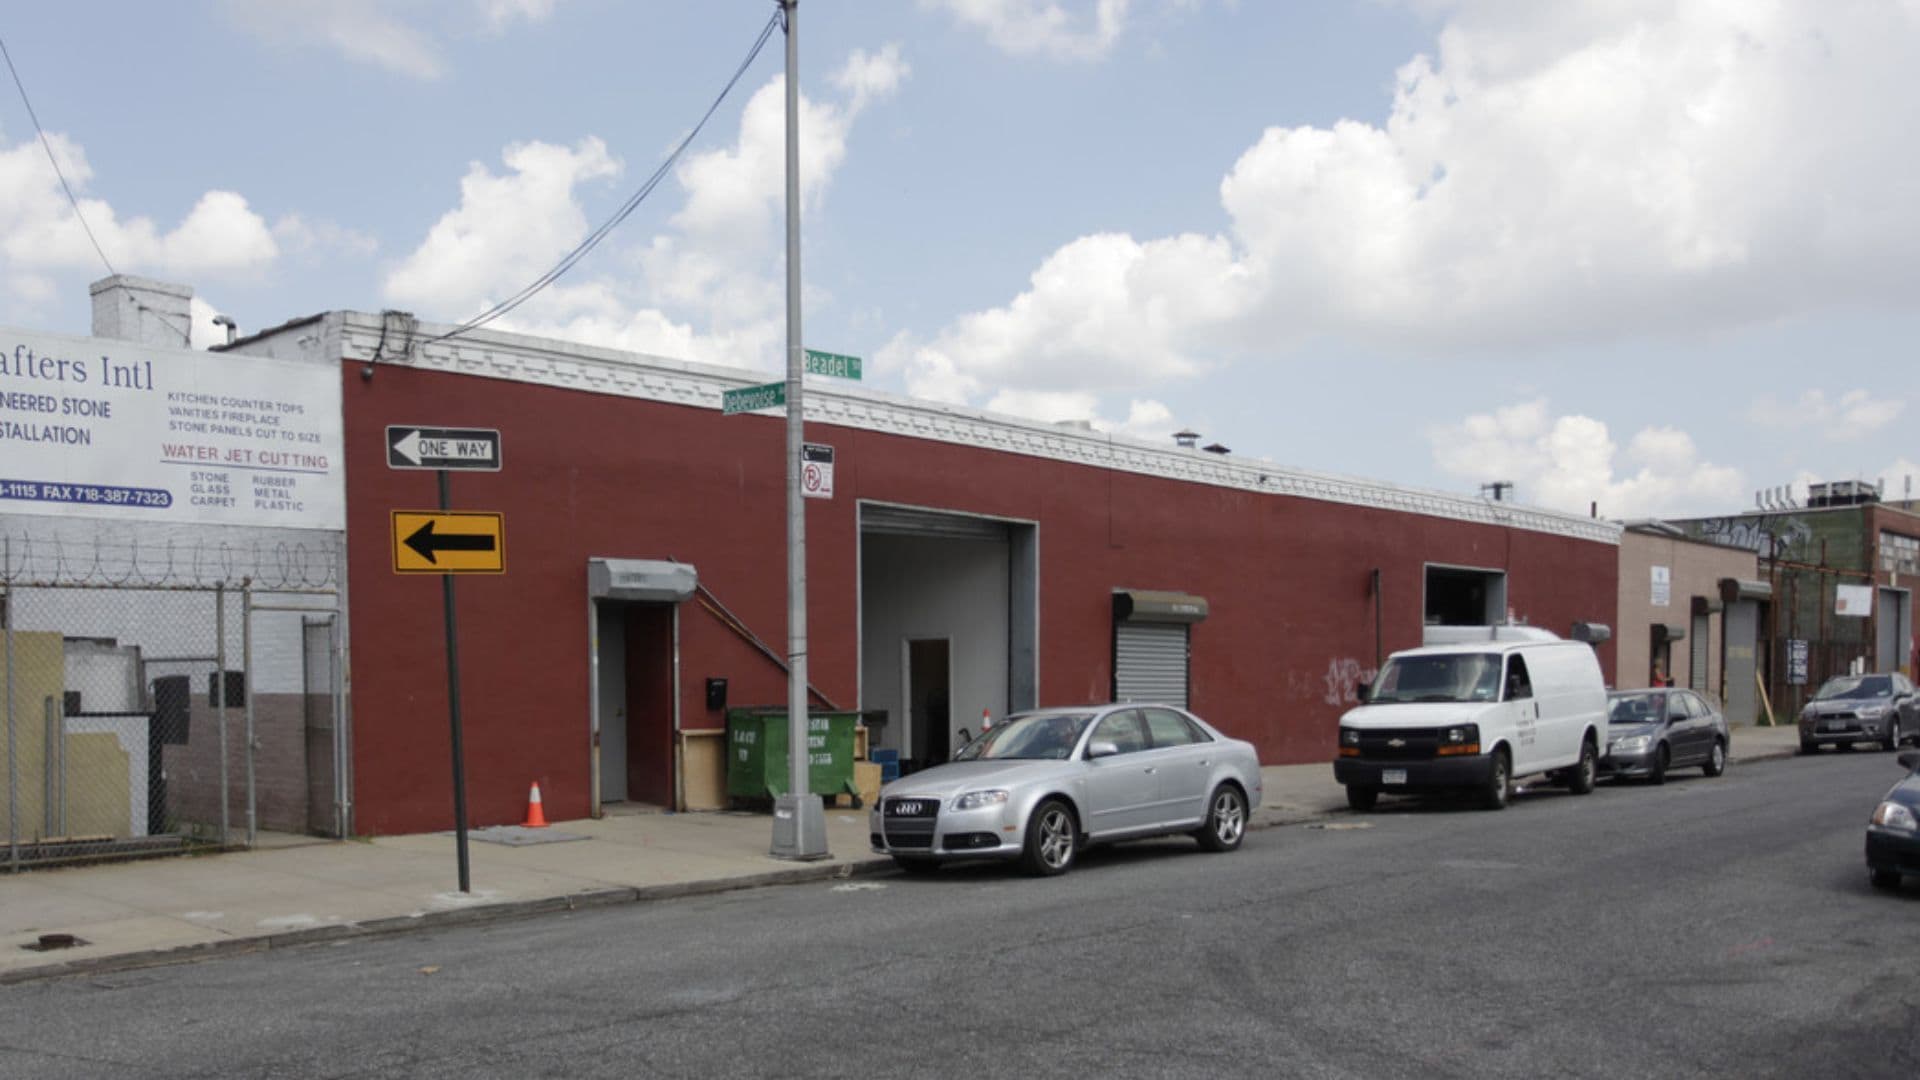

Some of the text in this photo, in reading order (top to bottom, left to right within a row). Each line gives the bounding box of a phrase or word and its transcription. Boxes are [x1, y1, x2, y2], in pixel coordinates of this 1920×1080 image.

[101, 356, 153, 390] Intl
[804, 351, 848, 377] Beadel
[62, 397, 111, 419] STONE
[168, 391, 304, 415] KITCHEN COUNTER TOPS
[168, 407, 280, 427] VANITIES FIREPLACE
[169, 420, 321, 444] STONE PANELS CUT TO SIZE
[162, 443, 329, 469] WATER JET CUTTING
[418, 440, 488, 457] ONE WAY
[190, 471, 230, 483] STONE
[252, 475, 296, 488] RUBBER
[43, 486, 72, 500] FAX
[75, 488, 168, 505] 718-387-7323
[190, 484, 230, 495] GLASS
[254, 487, 291, 499] METAL
[190, 496, 235, 508] CARPET
[254, 499, 304, 512] PLASTIC
